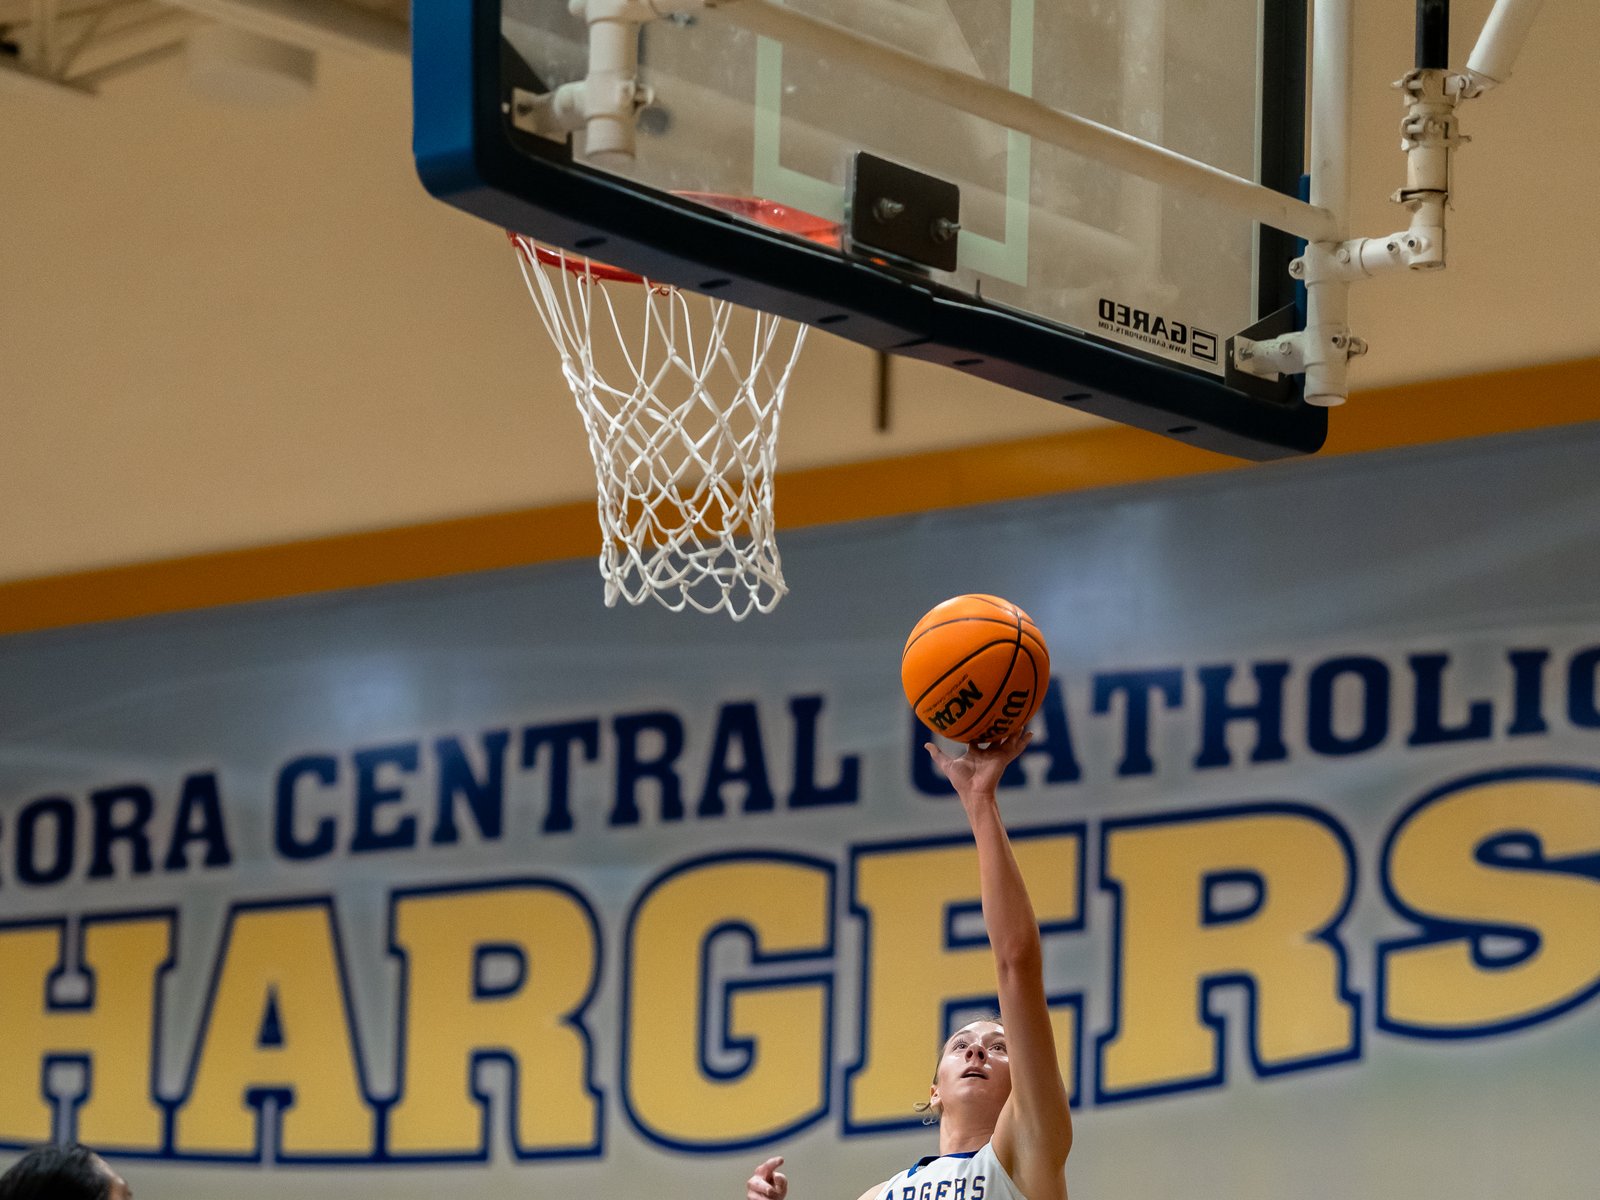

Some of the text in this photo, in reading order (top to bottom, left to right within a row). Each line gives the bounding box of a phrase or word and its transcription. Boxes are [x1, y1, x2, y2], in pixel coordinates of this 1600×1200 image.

[927, 679, 984, 731] NCAA
[0, 772, 232, 887] ORA
[275, 694, 860, 861] CENTRAL
